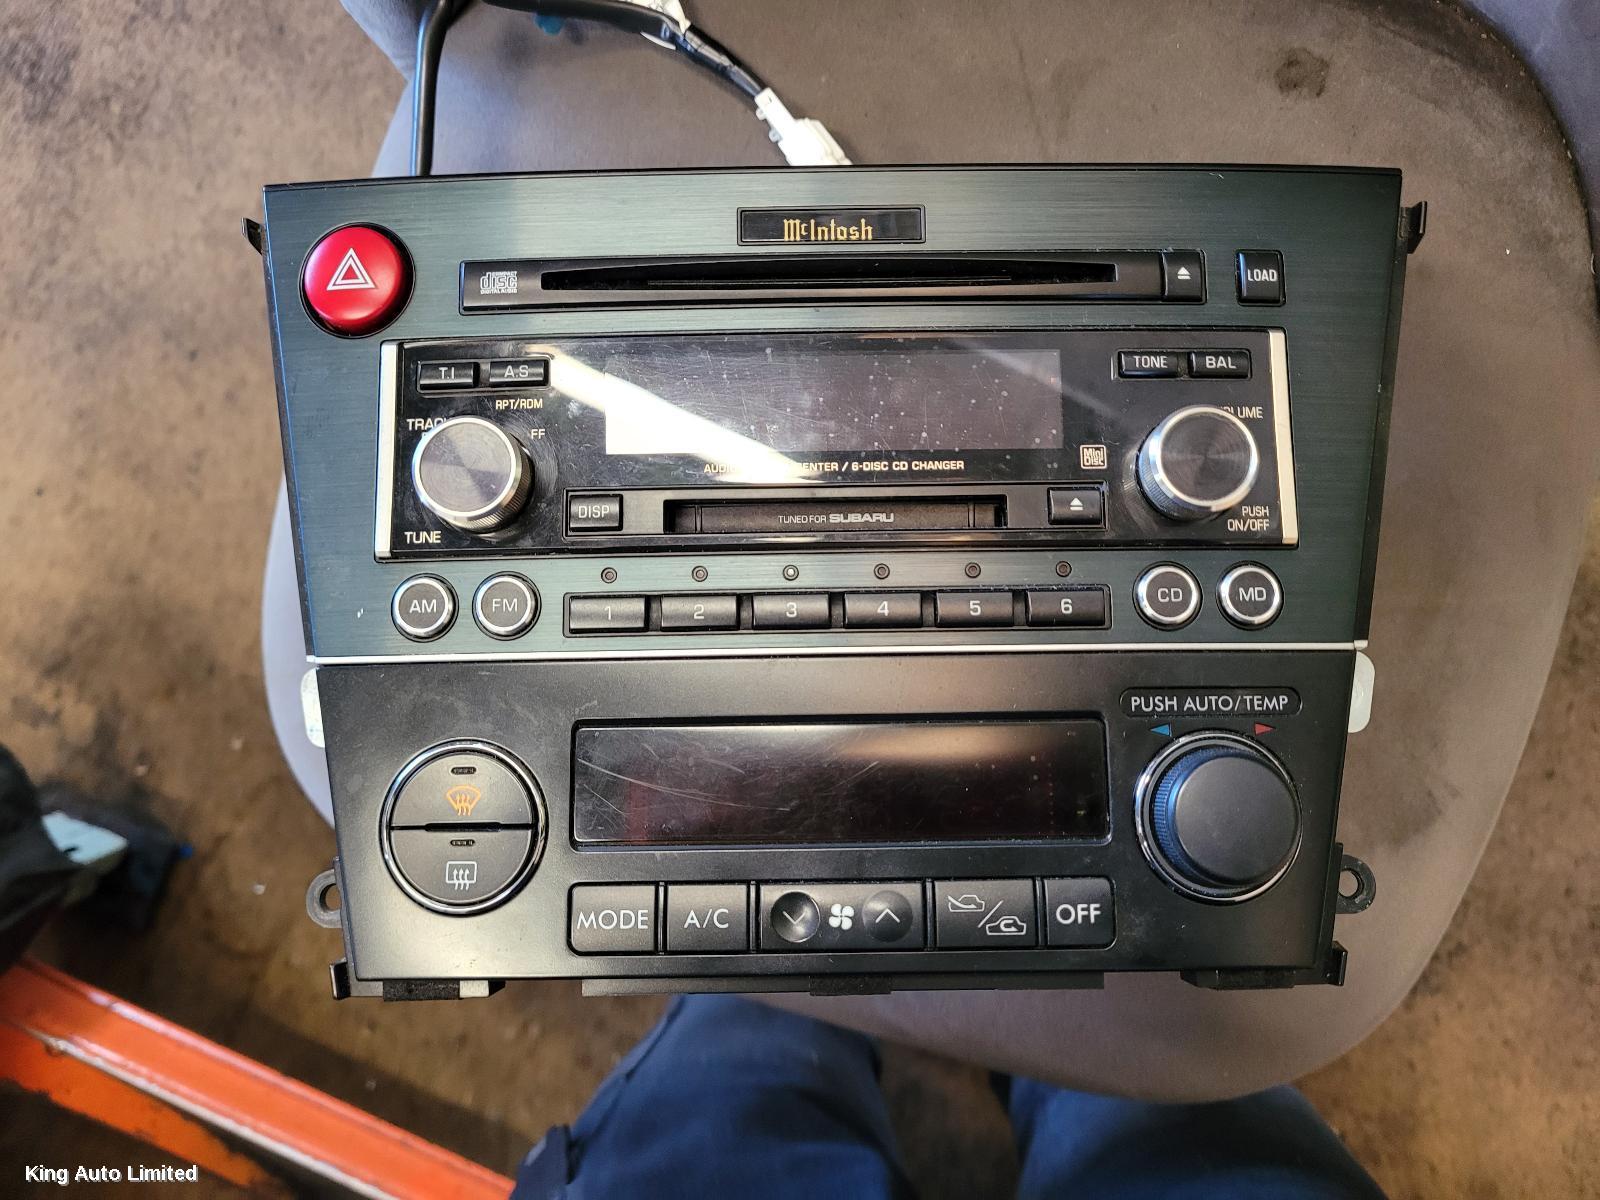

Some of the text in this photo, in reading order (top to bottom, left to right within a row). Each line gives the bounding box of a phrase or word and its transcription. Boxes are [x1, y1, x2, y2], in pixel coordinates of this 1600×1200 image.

[783, 217, 873, 242] McIntosh
[1247, 269, 1278, 282] LOAD
[1133, 355, 1168, 369] TONE
[1205, 355, 1237, 369] BAL
[504, 365, 529, 378] A.S
[495, 398, 543, 410] RPT/RDM
[406, 417, 447, 431] TRAC
[530, 428, 546, 440] FF
[1083, 447, 1104, 458] Mini
[851, 461, 889, 472] 6-DISC
[892, 460, 908, 471] CD
[911, 460, 965, 471] CHANGER
[578, 504, 610, 519] DISP
[777, 512, 895, 524] TUNED FOR SUBARU
[1241, 505, 1270, 517] PUSH
[1227, 518, 1270, 532] ON/OFF
[404, 530, 442, 544] TUNE
[1157, 587, 1183, 603] CD
[1238, 586, 1268, 602] MD
[409, 598, 438, 614] AM
[492, 597, 518, 613] FM
[604, 605, 612, 620] 1
[693, 603, 705, 619] 2
[785, 602, 798, 618] 3
[877, 600, 890, 616] 4
[969, 600, 982, 616] 5
[1060, 598, 1073, 614] 6
[1131, 695, 1289, 712] PUSH AUTO/TEMP
[576, 909, 649, 930] MODE
[683, 908, 730, 930] A/C
[1055, 903, 1101, 925] OFF
